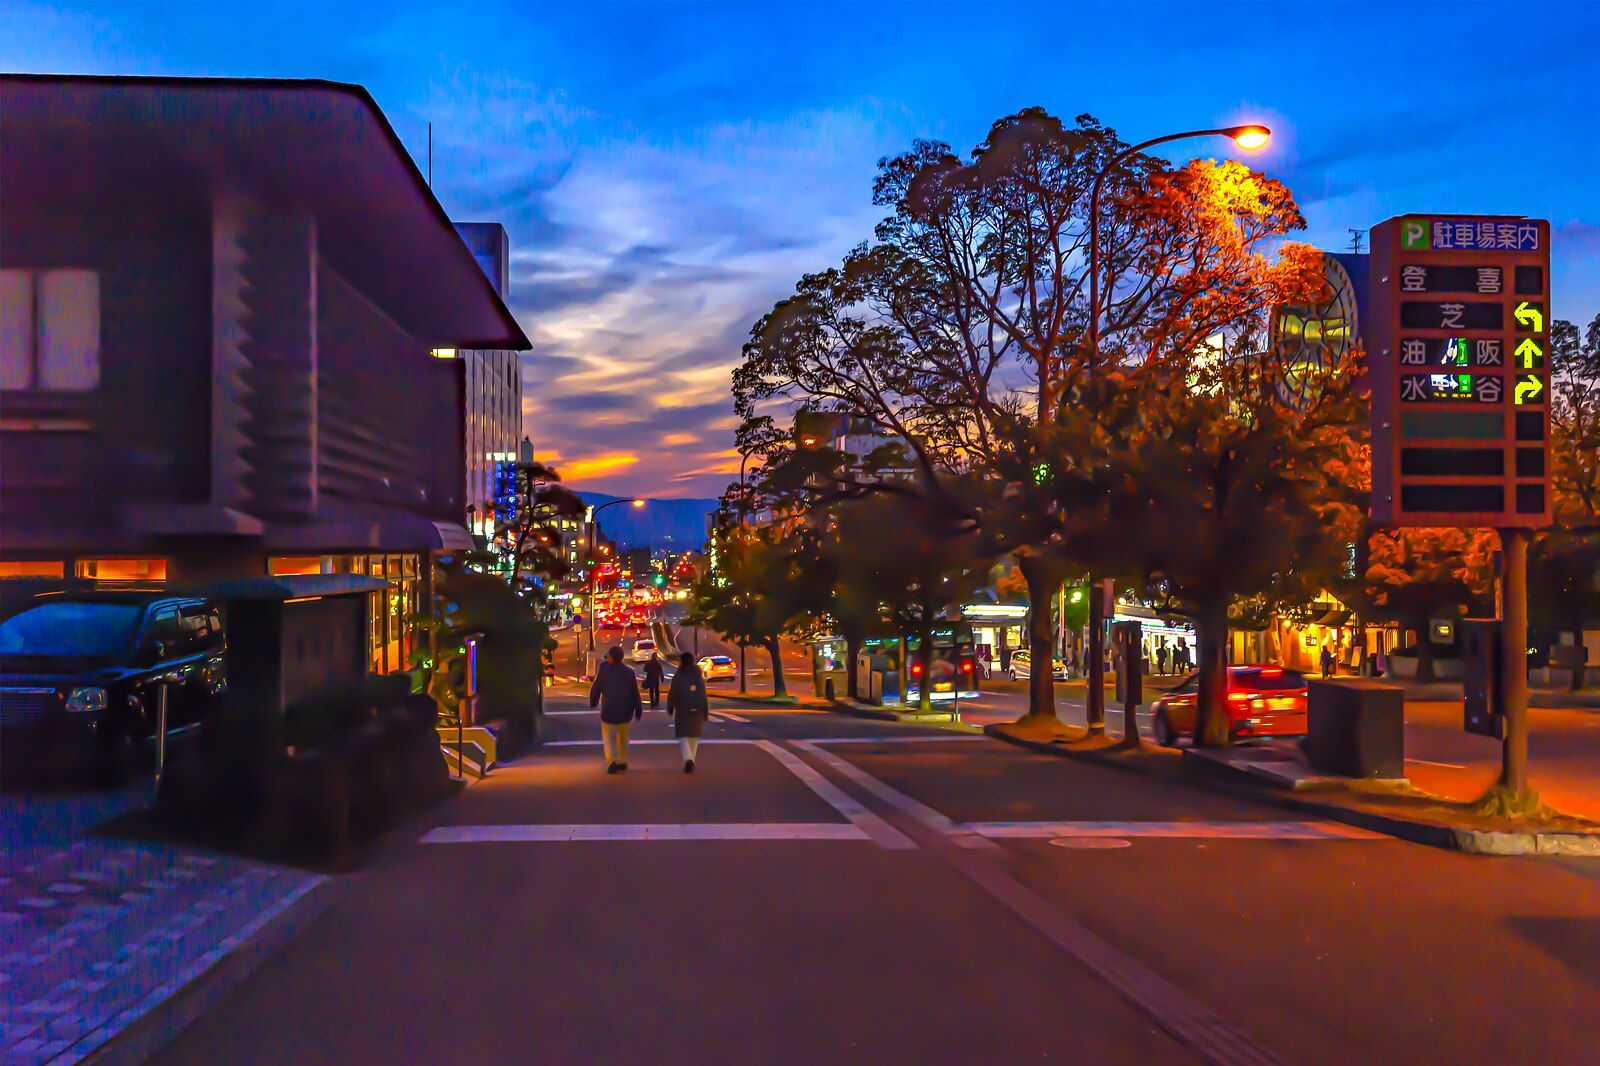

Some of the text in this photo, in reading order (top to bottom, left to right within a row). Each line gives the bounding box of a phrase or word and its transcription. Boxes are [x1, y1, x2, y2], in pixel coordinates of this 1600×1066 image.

[1407, 223, 1424, 247] P
[1433, 222, 1539, 250] 駐車場案内
[1440, 303, 1466, 328] 芝
